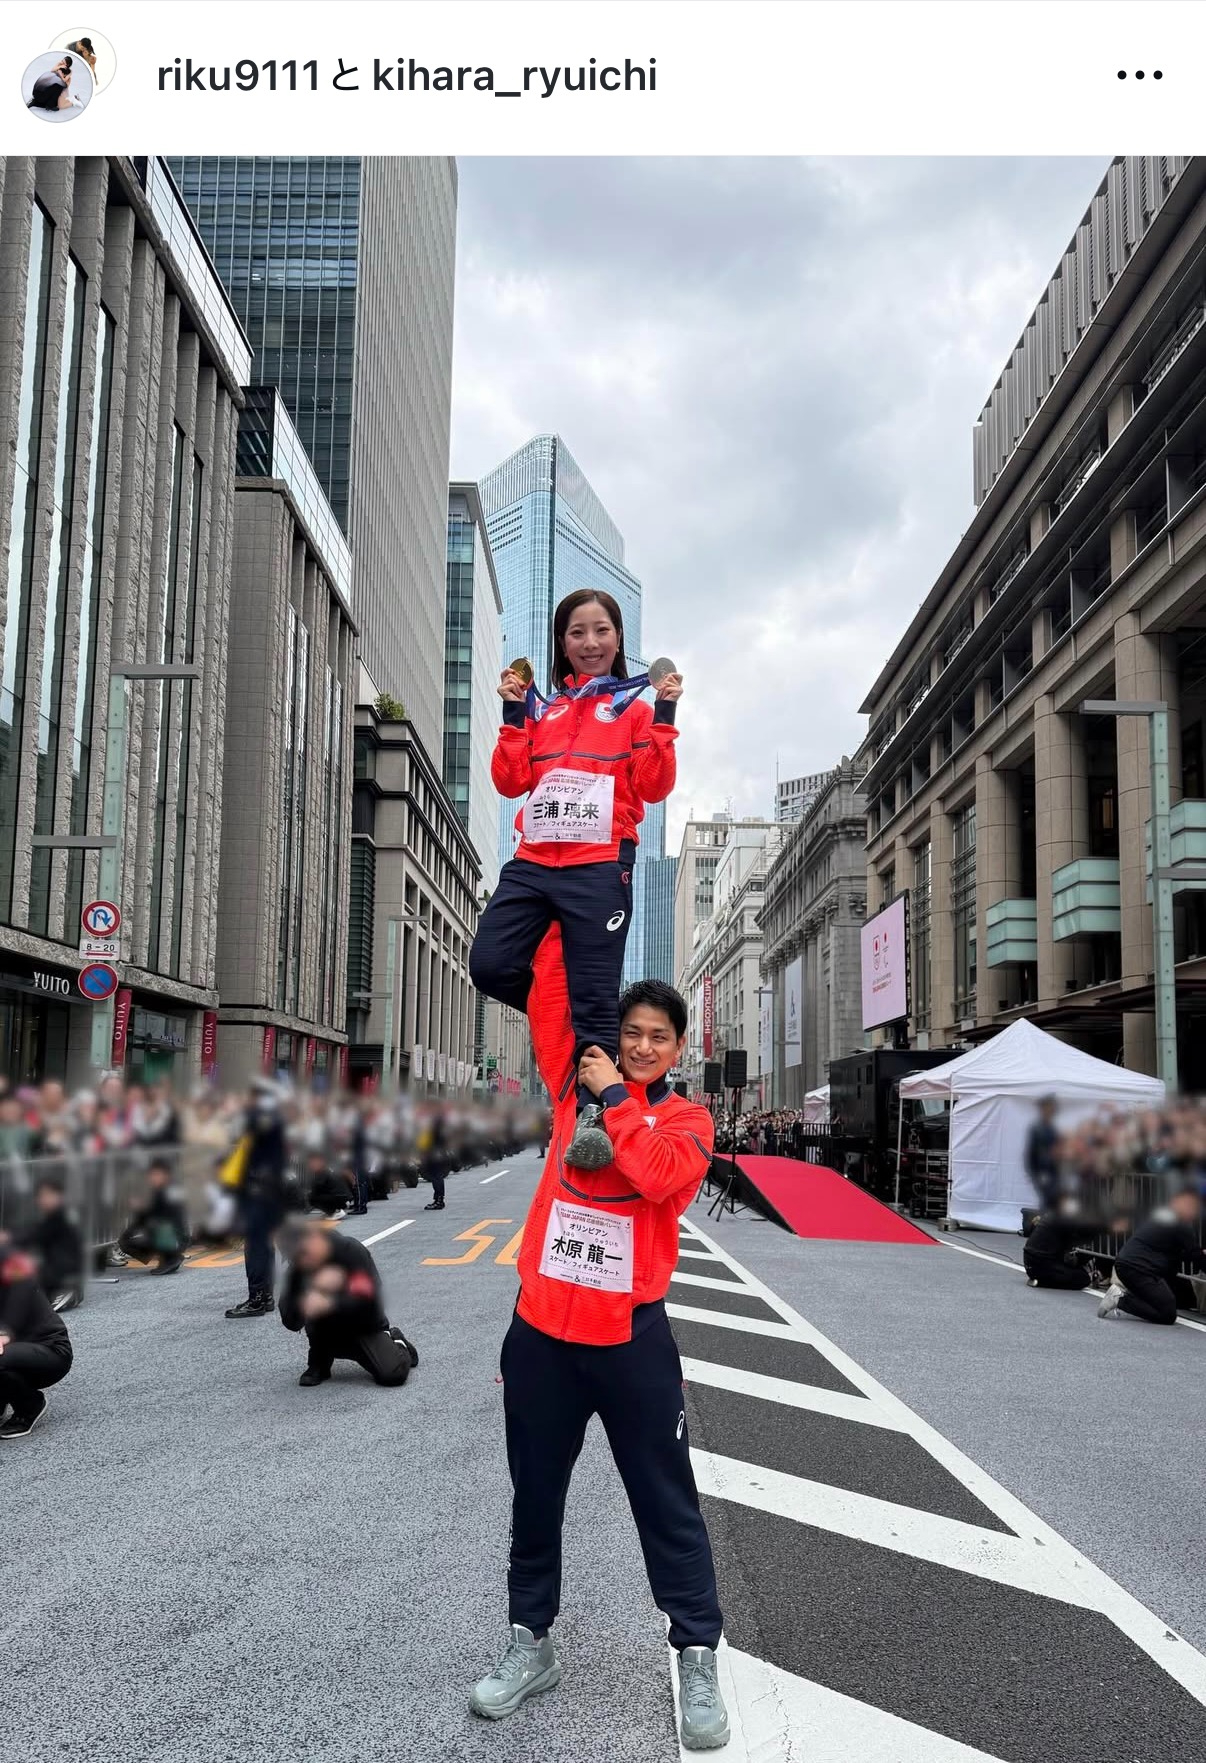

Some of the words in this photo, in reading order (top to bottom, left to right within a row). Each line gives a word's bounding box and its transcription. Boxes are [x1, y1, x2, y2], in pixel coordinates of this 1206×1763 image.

[33, 971, 70, 995] YUITO
[704, 980, 712, 1034] MITSUKOSHI
[114, 1002, 126, 1041] YUITO
[204, 1022, 214, 1054] YUITO
[569, 1223, 608, 1237] オリンピアン
[551, 1235, 585, 1259] 木原
